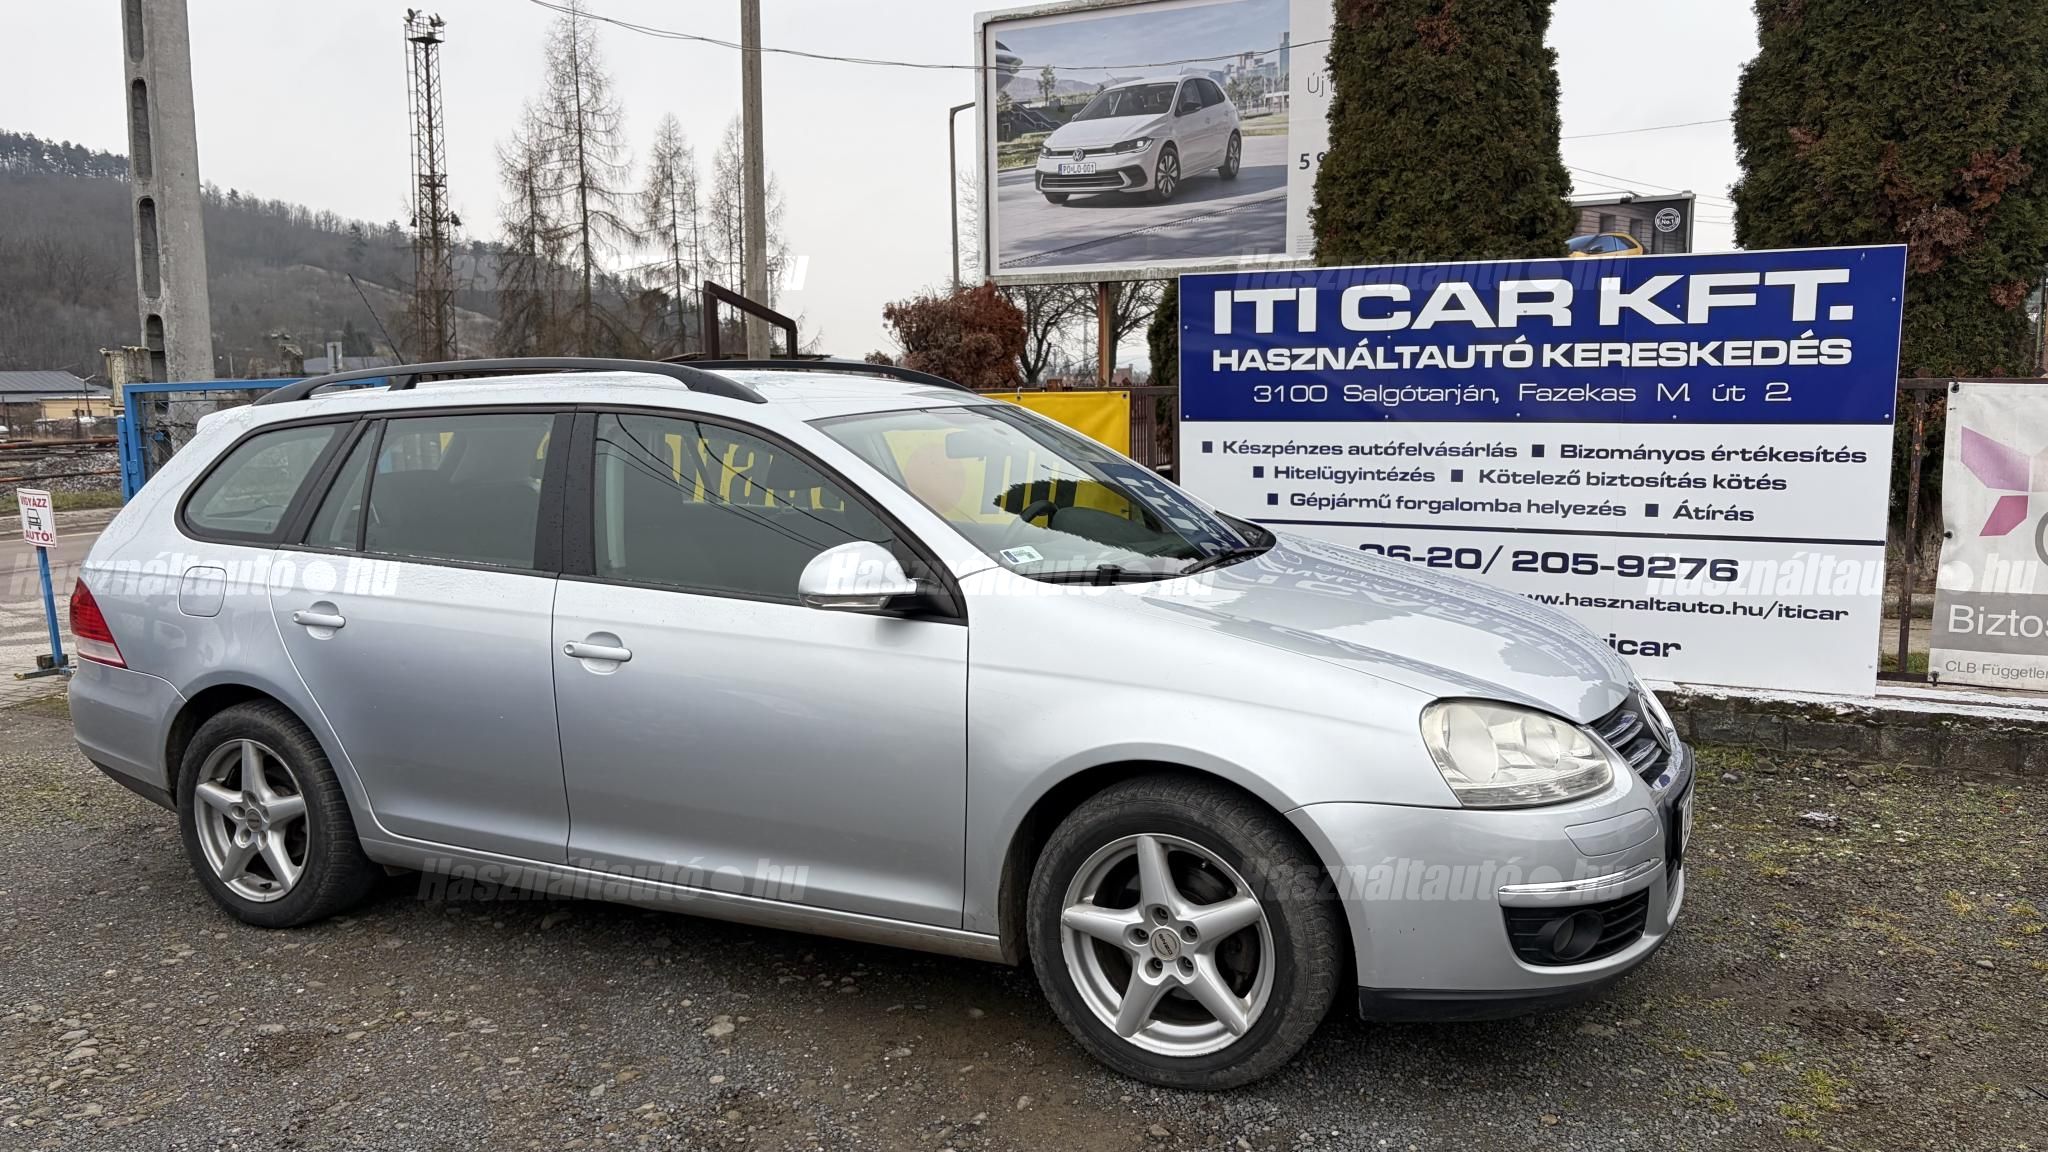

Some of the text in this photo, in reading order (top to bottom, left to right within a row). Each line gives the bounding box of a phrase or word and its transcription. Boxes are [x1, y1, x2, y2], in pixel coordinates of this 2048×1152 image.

[1213, 268, 1854, 335] ITI CAR KFT.
[1213, 329, 1852, 372] HASZNÁLTAUTÓ KERESKEDÉS
[1253, 384, 1328, 403] 3100
[1343, 383, 1500, 407] Salgótarján,
[1518, 383, 1637, 402] Fazekas
[1712, 383, 1746, 402] út
[1222, 439, 1518, 459] Készpénzes autófelvásárlás
[1560, 443, 1867, 465] Bizományos értékesítés
[1274, 465, 1436, 485] Hitelügyintézés
[1479, 468, 1788, 491] Kötelező biztosítás kötés
[1290, 491, 1627, 519] Gépjármű forgalomba helyezés
[1672, 499, 1755, 522] Átírás
[1511, 550, 1740, 582] 205-9276
[1602, 633, 1682, 657] icar
[1945, 660, 2048, 679] CLB Függetle
